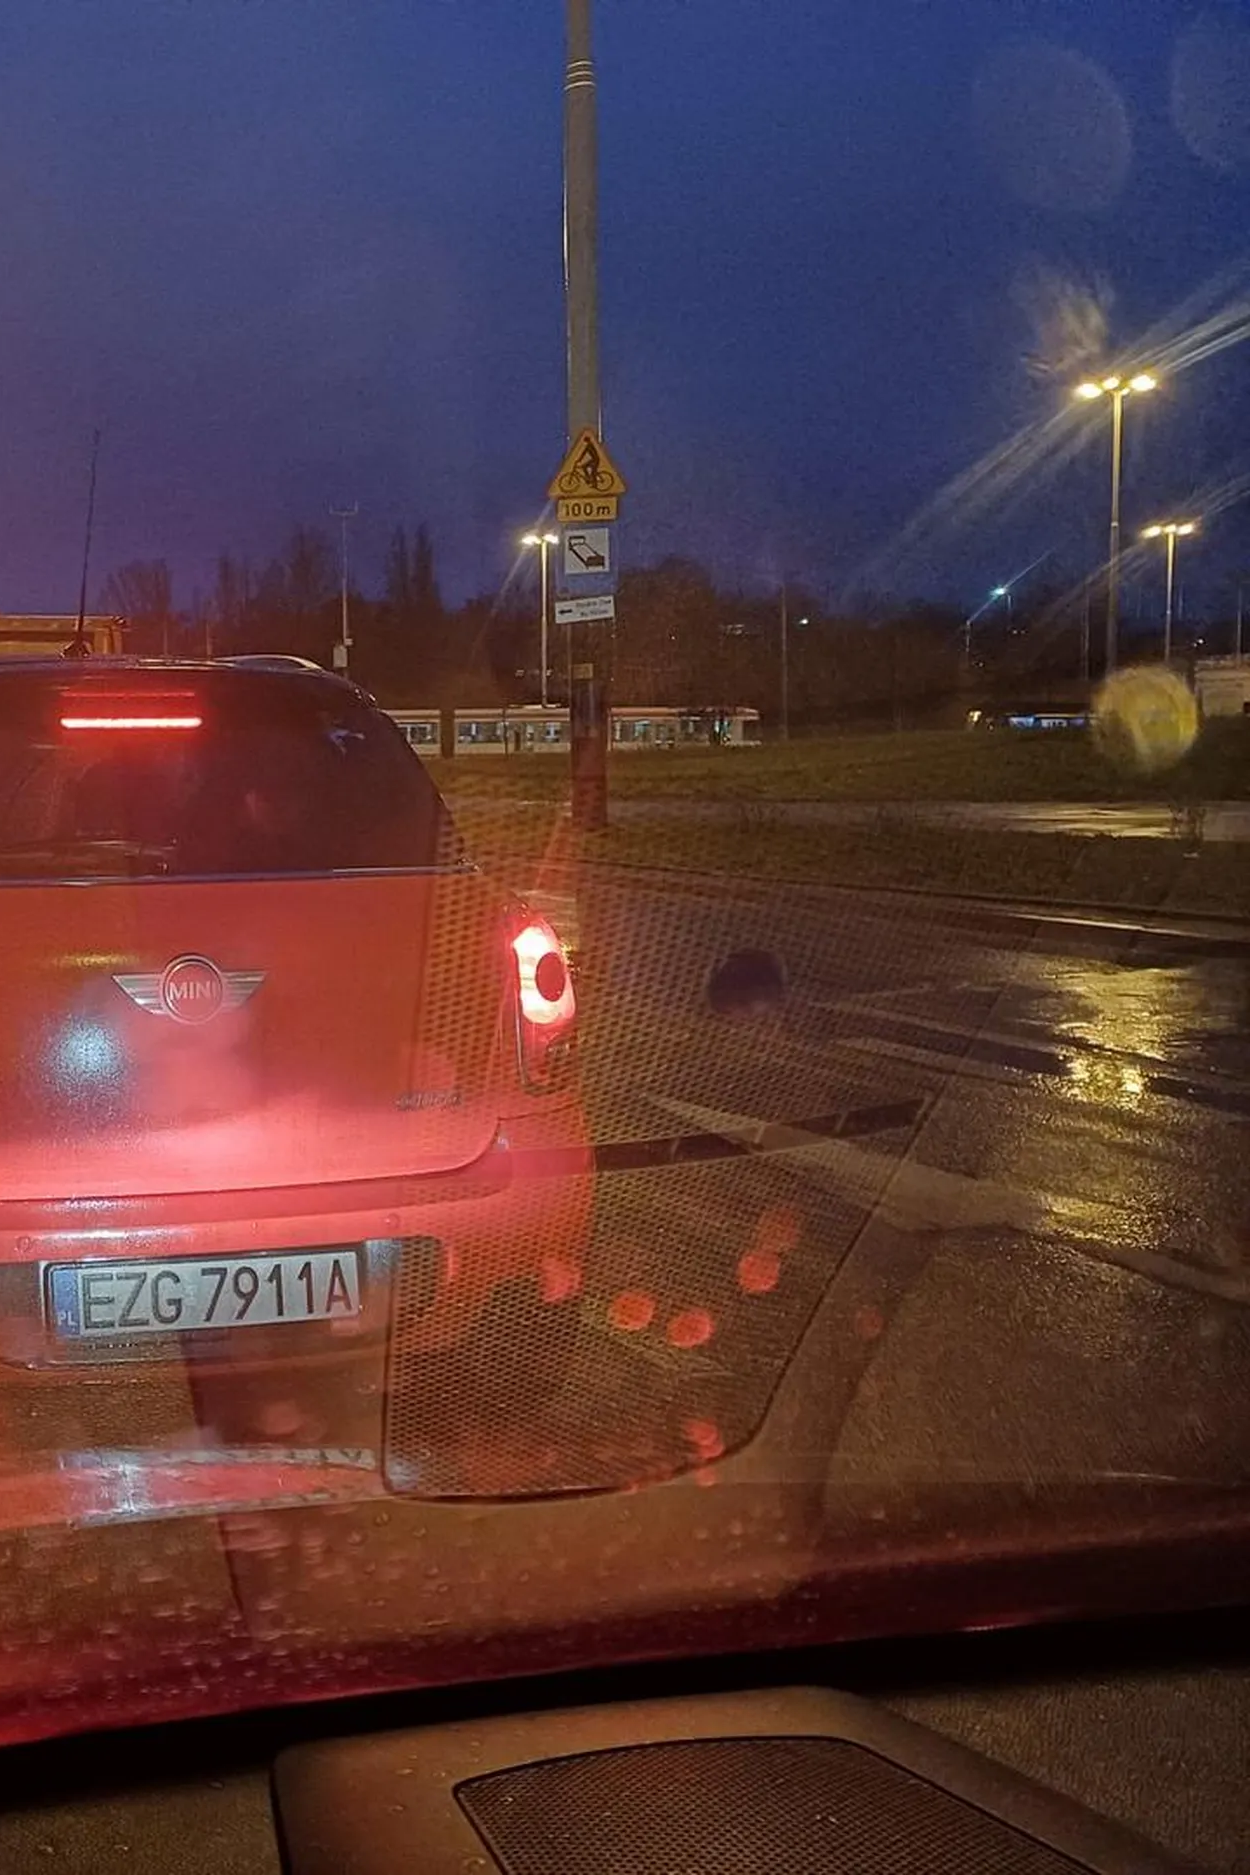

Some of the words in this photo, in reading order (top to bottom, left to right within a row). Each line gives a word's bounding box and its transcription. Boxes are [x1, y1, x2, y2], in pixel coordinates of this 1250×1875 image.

[169, 981, 217, 1000] MINI
[81, 1270, 181, 1330] EZG
[200, 1259, 352, 1322] 7911A
[57, 1310, 78, 1326] PL
